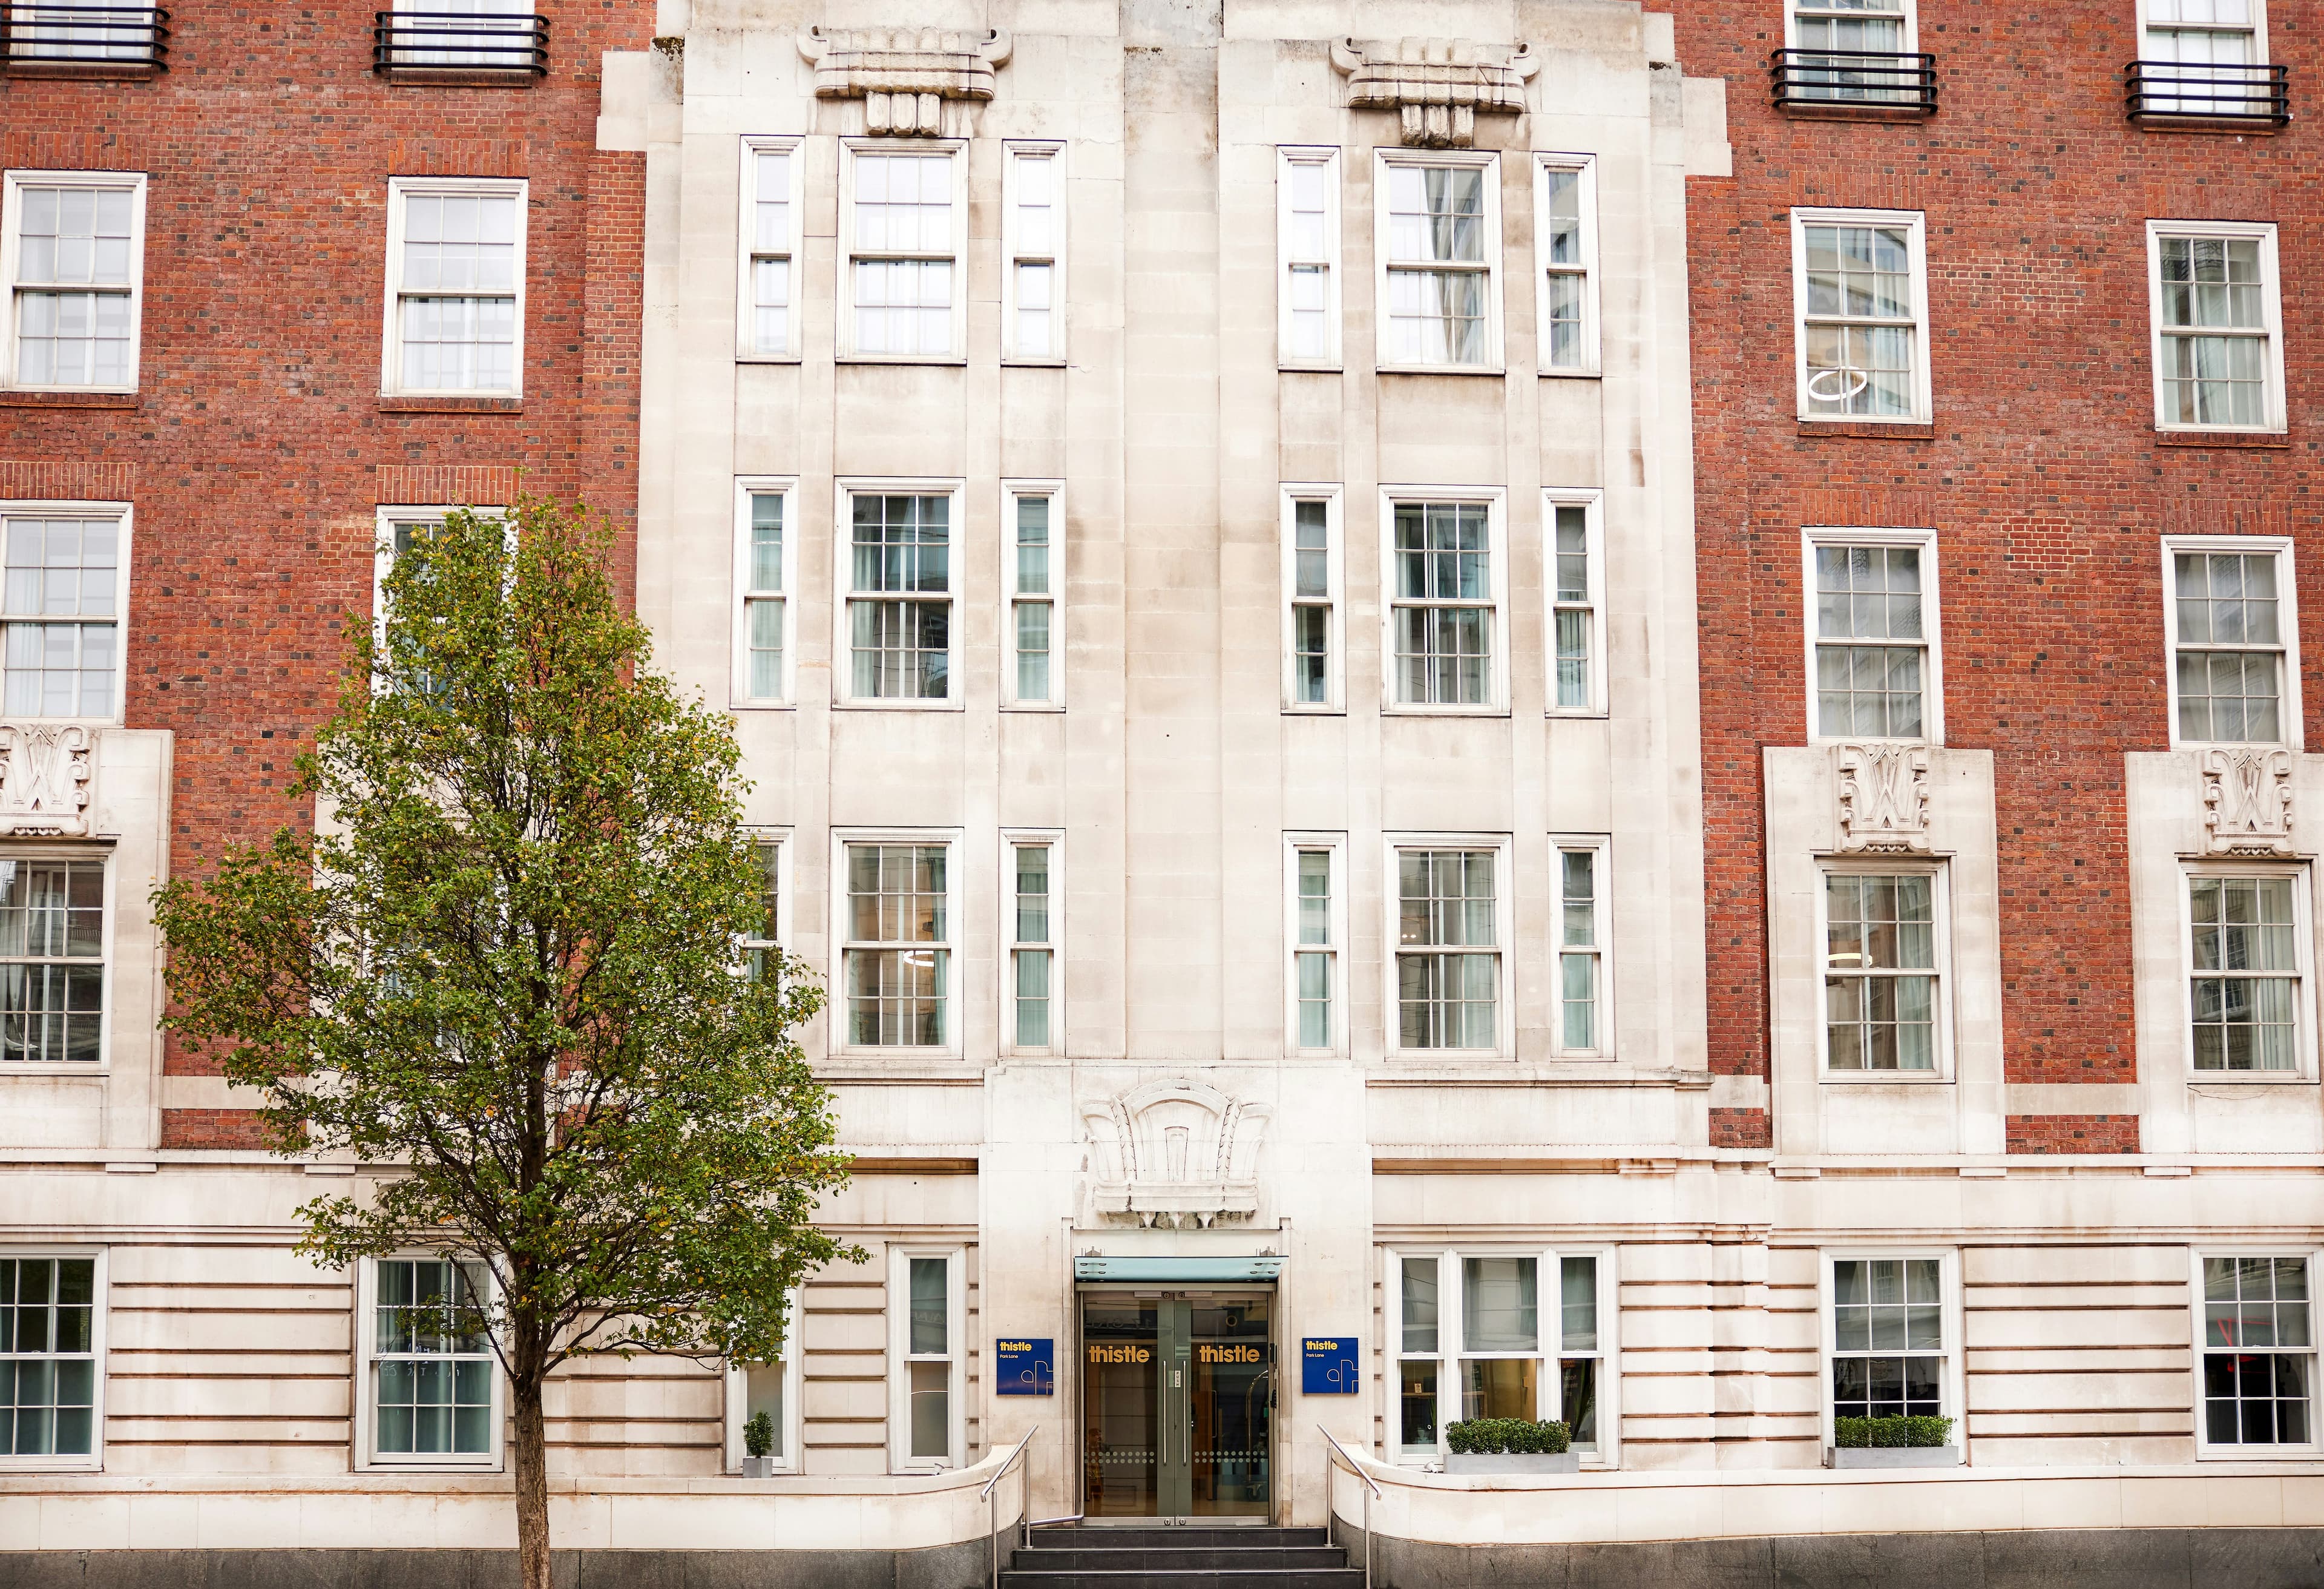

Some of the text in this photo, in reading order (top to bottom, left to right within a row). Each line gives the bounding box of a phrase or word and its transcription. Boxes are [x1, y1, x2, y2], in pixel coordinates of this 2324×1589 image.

[1000, 1341, 1032, 1351] thistle
[1306, 1341, 1338, 1350] thistle
[1089, 1346, 1150, 1363] thistle
[1199, 1345, 1260, 1363] thistle
